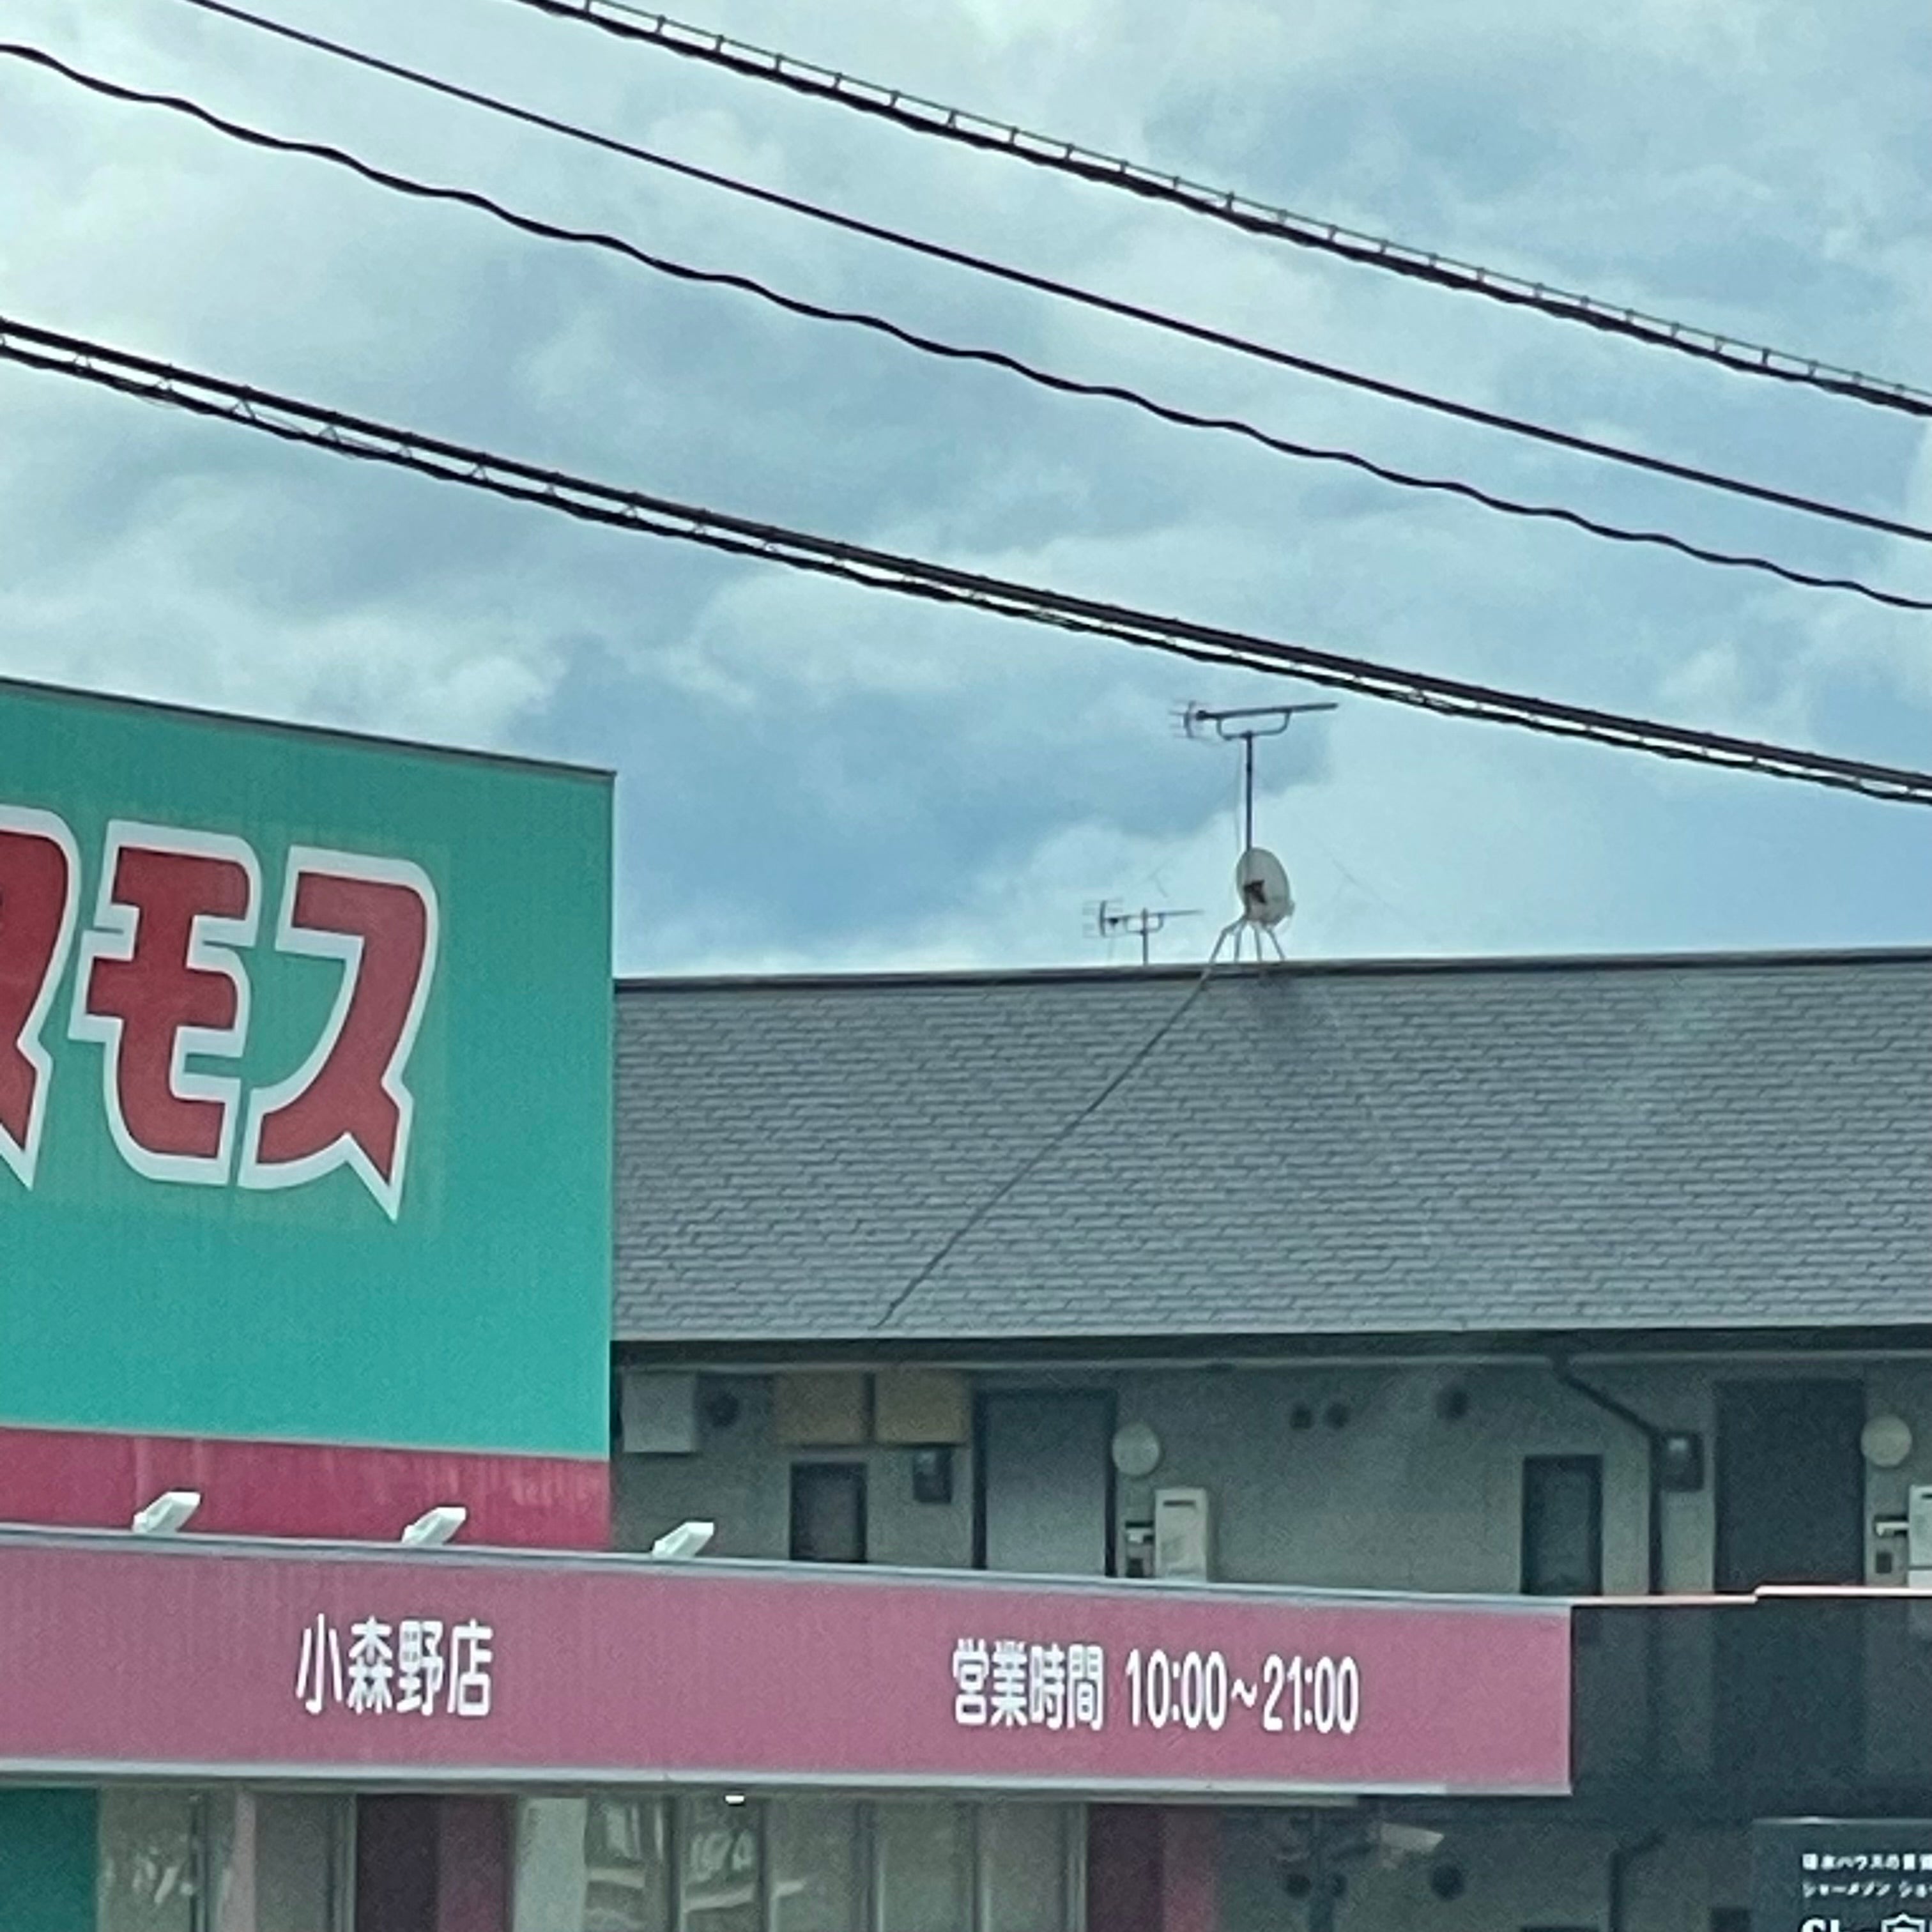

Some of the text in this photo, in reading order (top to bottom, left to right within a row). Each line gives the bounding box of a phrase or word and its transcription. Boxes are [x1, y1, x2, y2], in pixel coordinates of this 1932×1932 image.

[296, 1613, 493, 1716] 小森野店
[953, 1638, 1104, 1731] 営業時間
